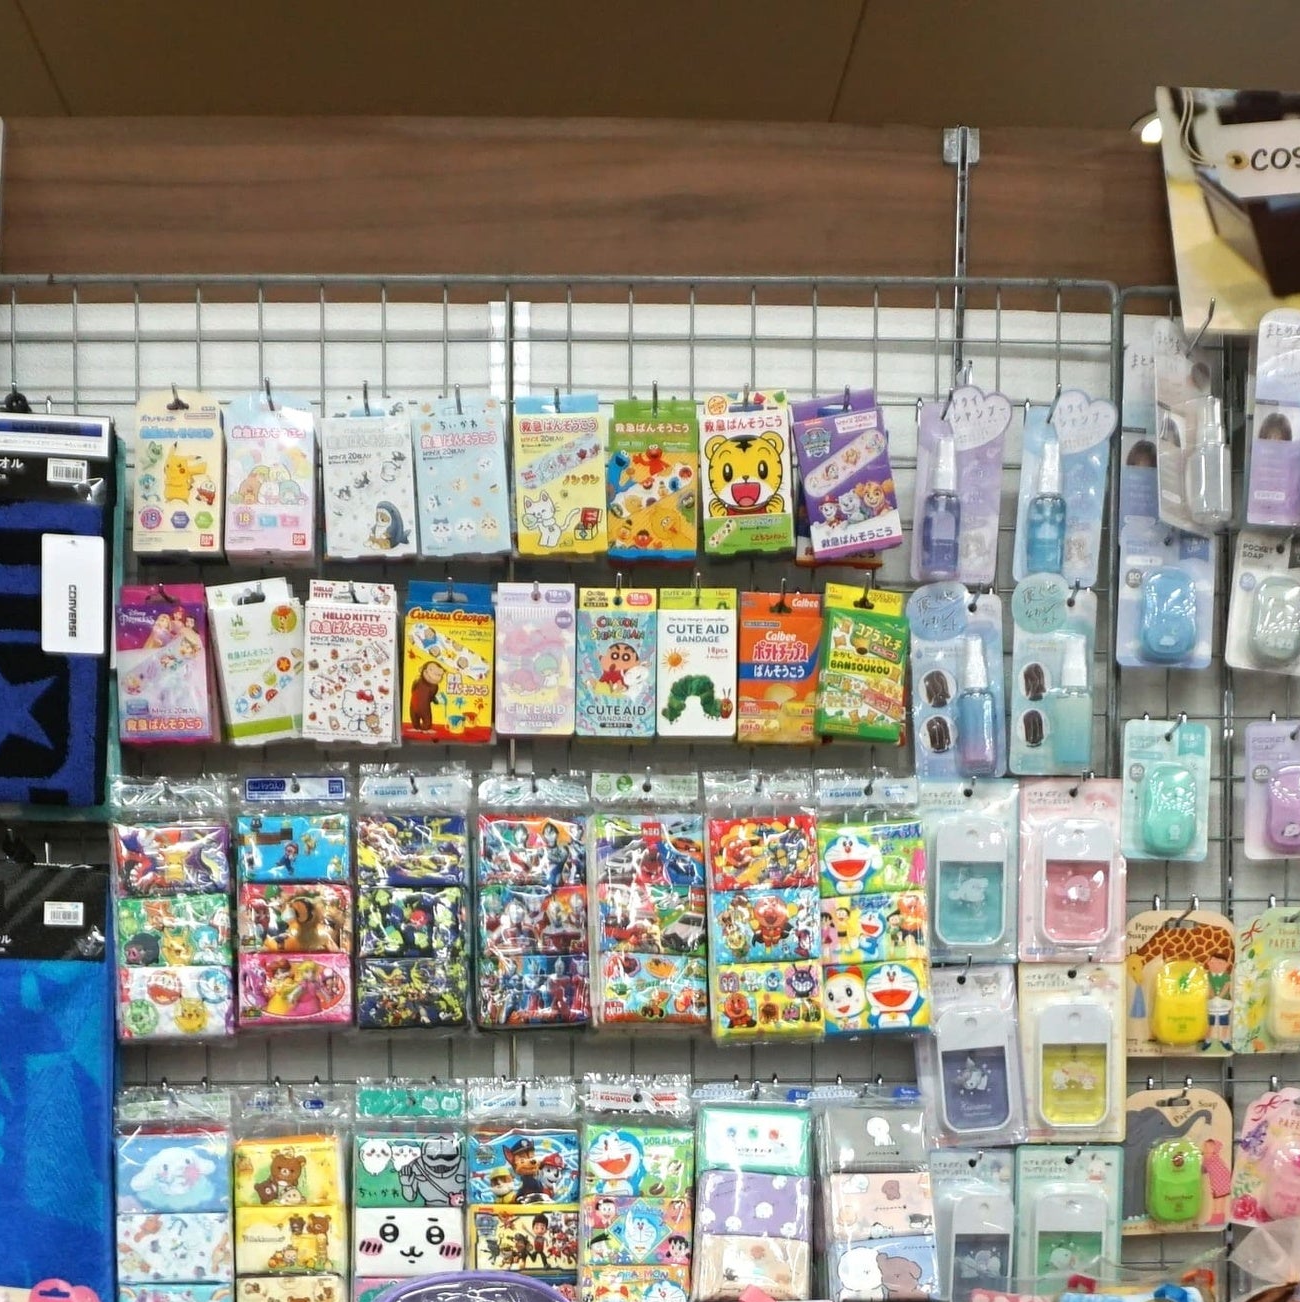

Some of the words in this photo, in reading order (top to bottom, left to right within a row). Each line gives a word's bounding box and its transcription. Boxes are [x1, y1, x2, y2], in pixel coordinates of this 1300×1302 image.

[518, 418, 598, 433] 救急ばんそうこう
[615, 422, 689, 433] 救急ばんそうこう
[704, 416, 783, 434] 救急ばんそうこう
[821, 528, 893, 548] 救急ばんそうこう
[792, 598, 819, 608] Calbee
[69, 584, 77, 638] CONVERSE
[322, 612, 351, 621] HELLO
[353, 613, 380, 621] KITTY
[409, 607, 451, 621] Curious
[454, 610, 491, 625] George
[309, 621, 388, 636] 救急ばんそうこう
[667, 624, 703, 634] CUTE
[706, 624, 728, 634] AID
[766, 631, 796, 642] Calbee
[753, 641, 809, 662] ポテトチップス
[754, 666, 804, 678] ばんそうこう
[506, 705, 541, 715] CUTE
[544, 705, 565, 714] AID
[586, 705, 624, 715] CUTE
[626, 705, 646, 715] AID
[126, 717, 203, 731] 救急ばんそうこう
[1135, 922, 1159, 932] Paper
[1269, 939, 1298, 948] PAPER
